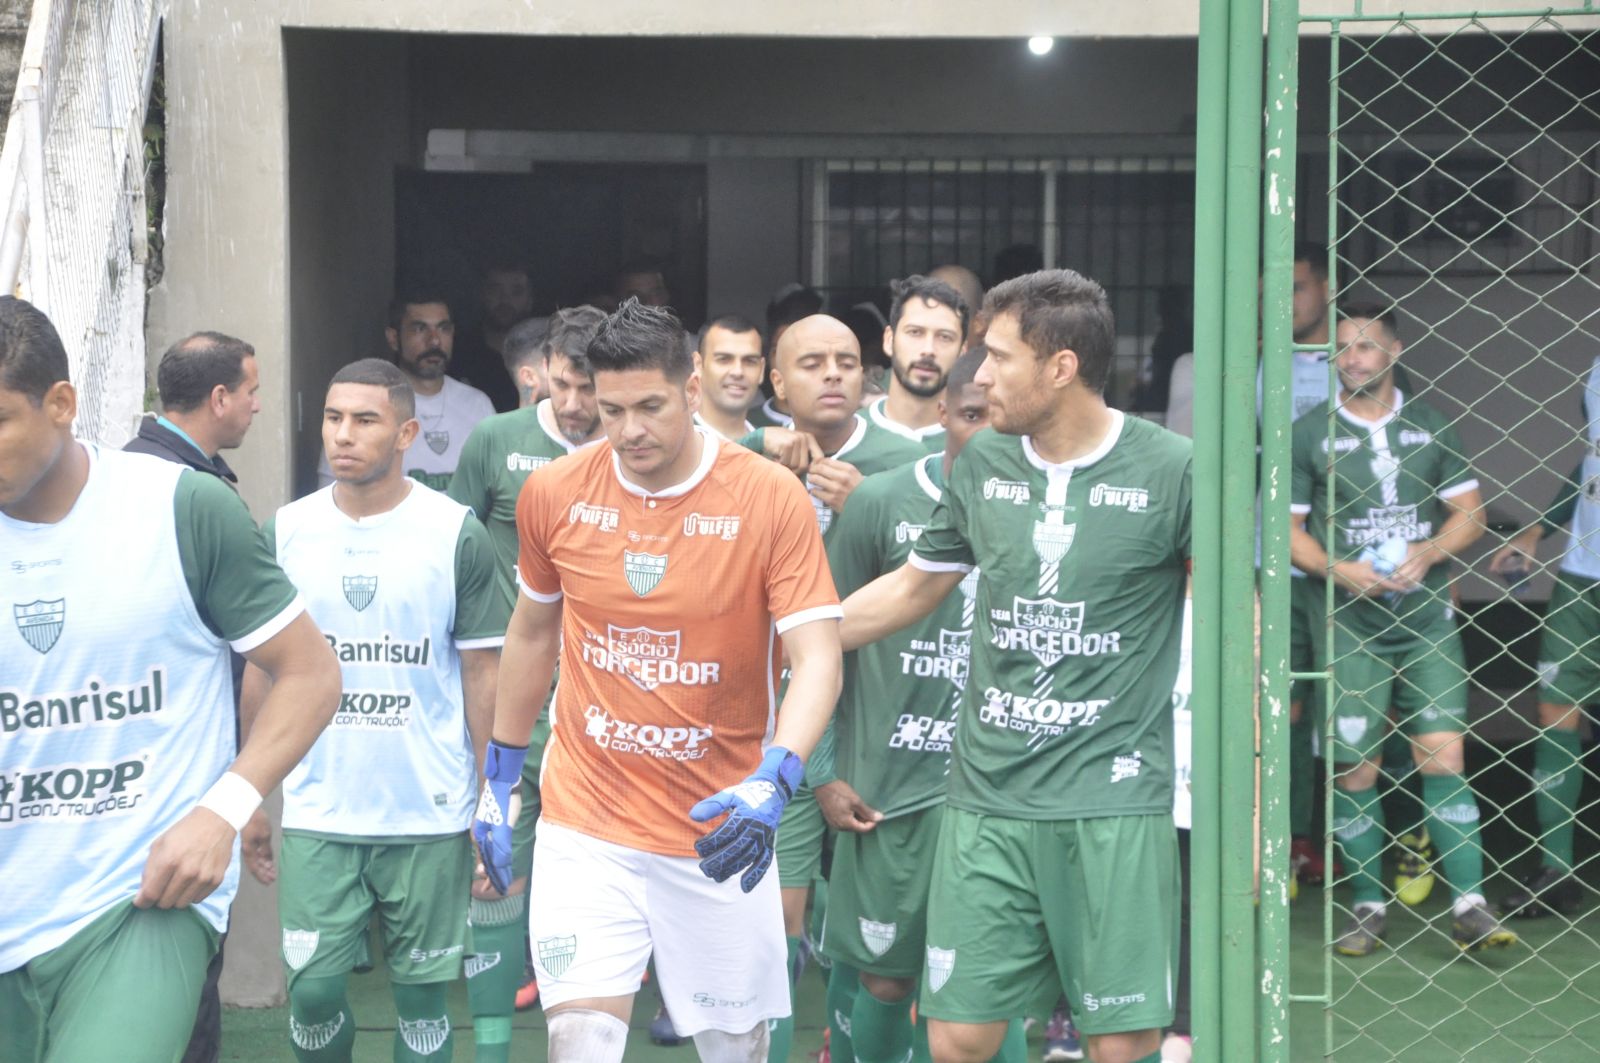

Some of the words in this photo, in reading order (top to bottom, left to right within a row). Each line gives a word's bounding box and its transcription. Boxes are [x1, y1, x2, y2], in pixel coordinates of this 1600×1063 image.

[1022, 610, 1072, 630] SÓCIO
[1026, 604, 1034, 613] E
[1061, 607, 1070, 617] C
[616, 638, 669, 658] SÓCIO
[910, 639, 936, 652] SEJA
[582, 641, 720, 686] TORCEDOR
[0, 670, 163, 733] Banrisul
[338, 693, 411, 715] KOPP
[614, 719, 713, 749] KOPP
[19, 760, 145, 803] KOPP
[1100, 992, 1146, 1006] SPORTS
